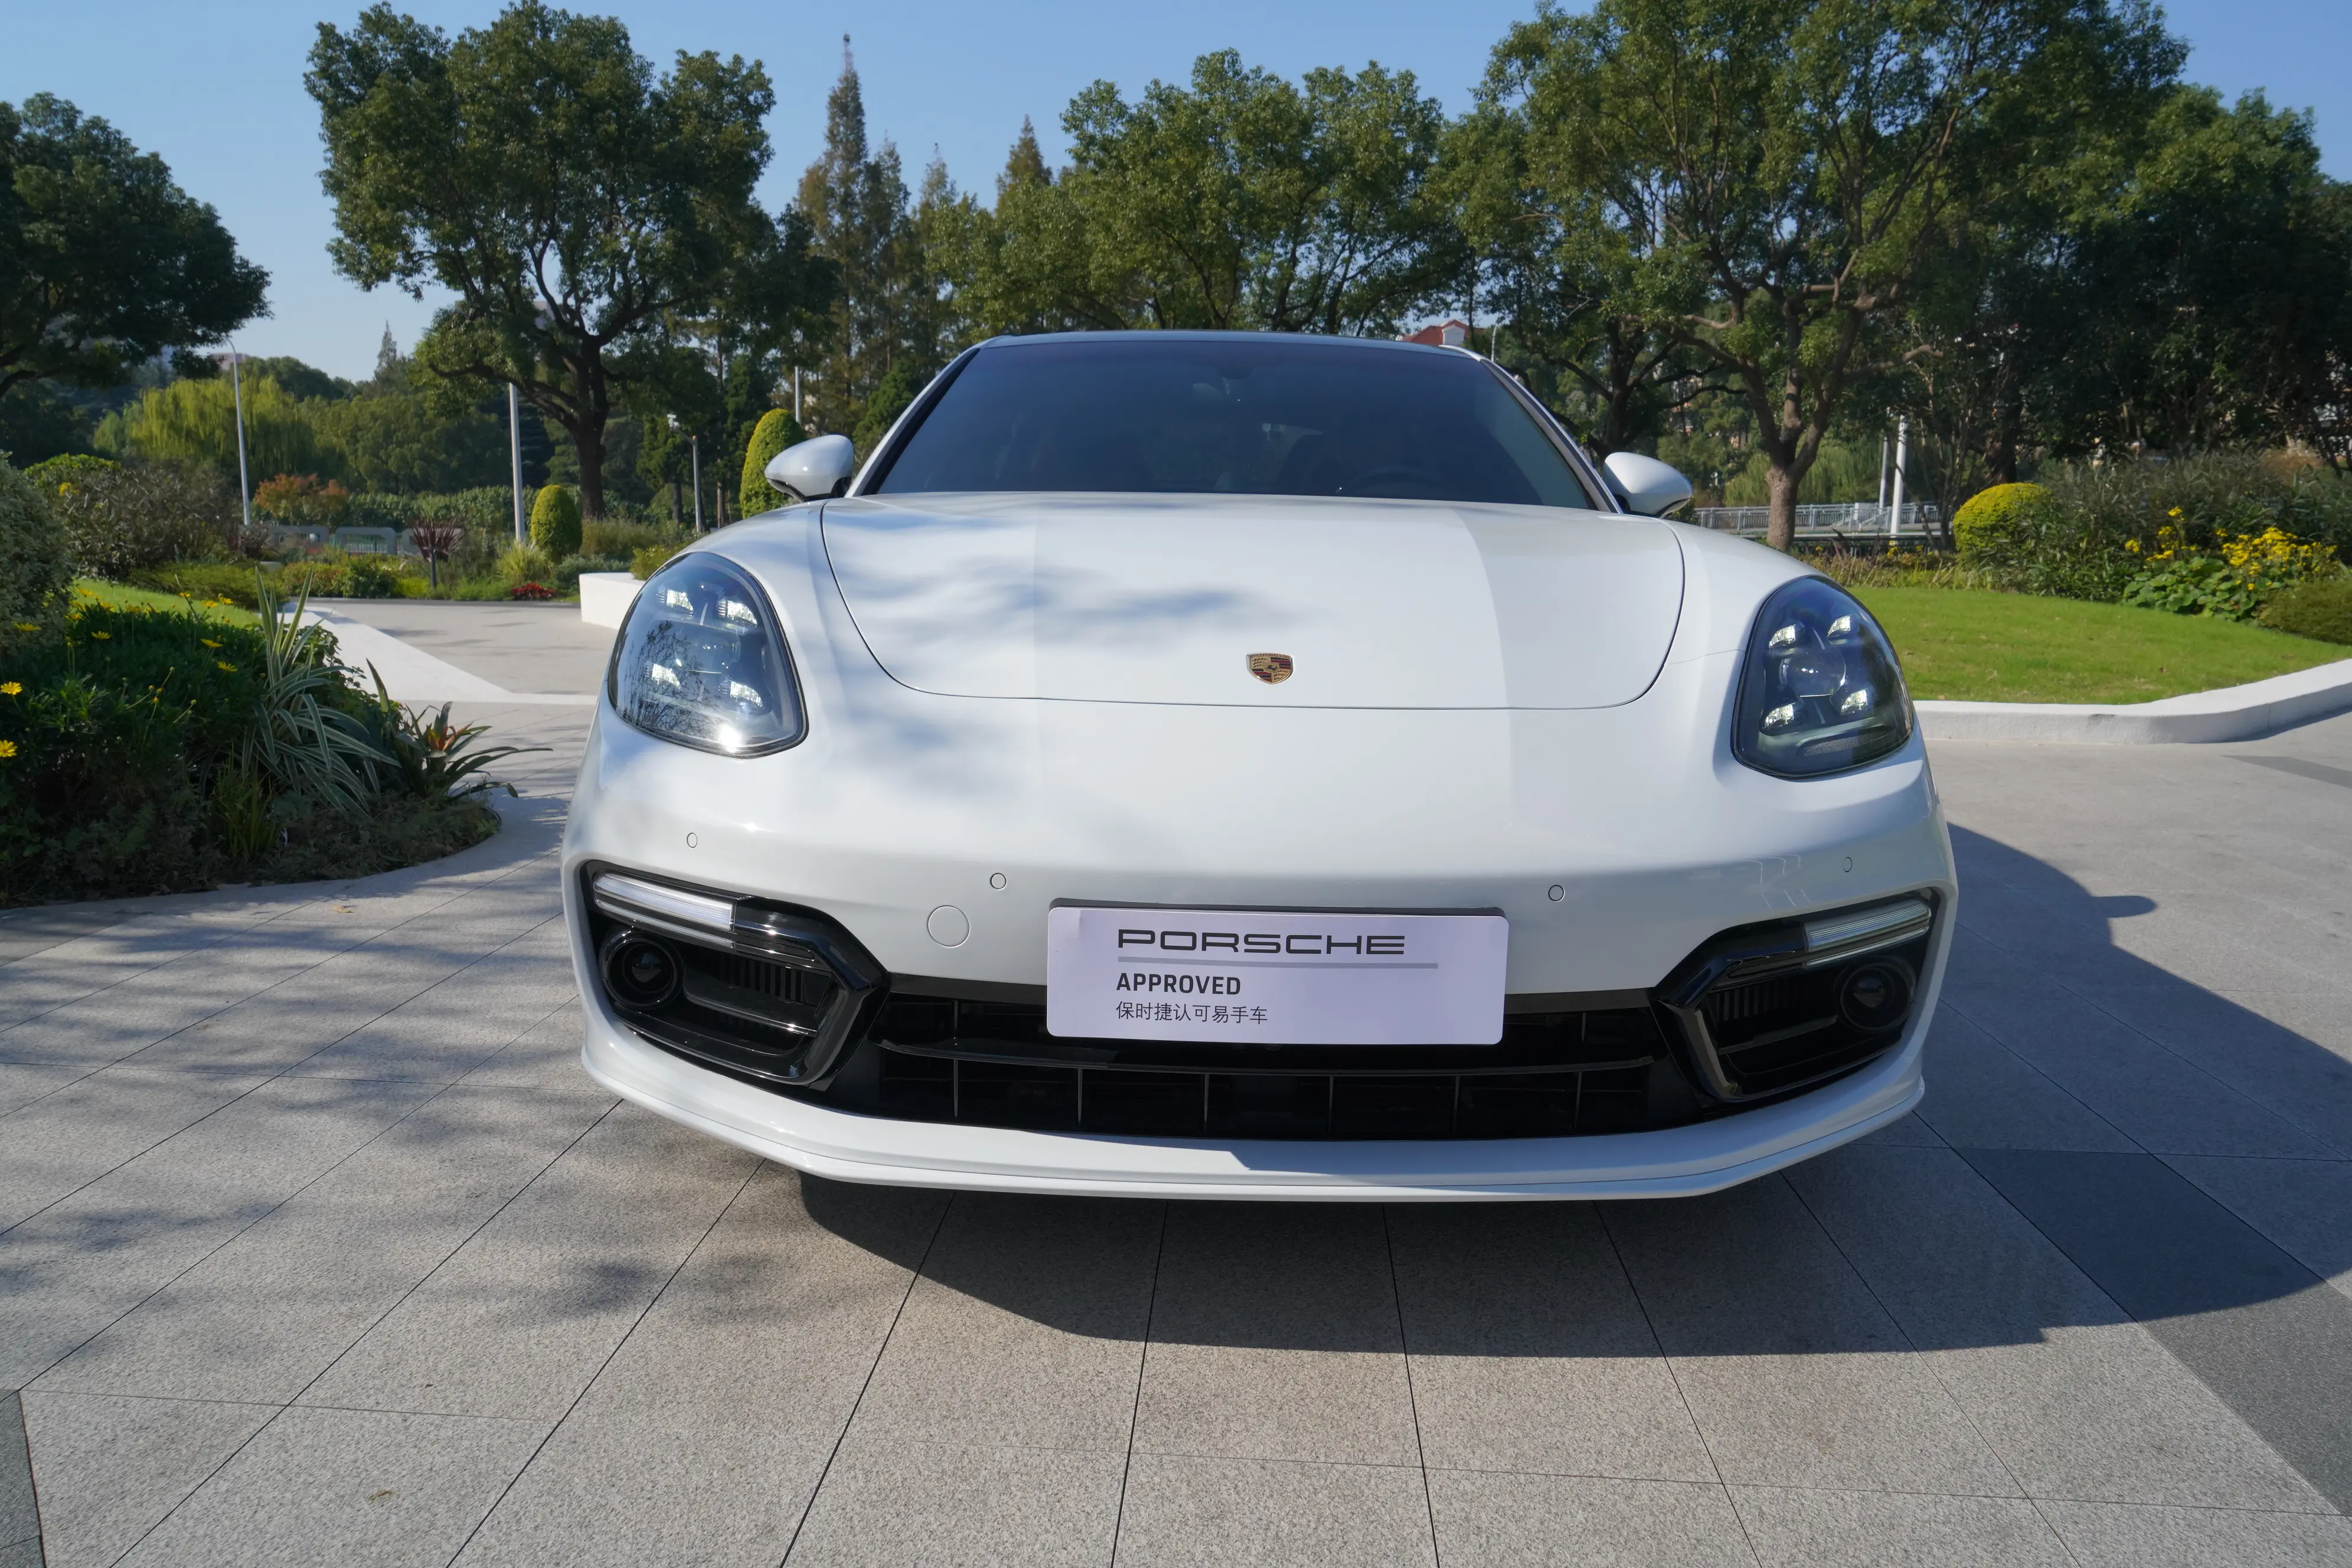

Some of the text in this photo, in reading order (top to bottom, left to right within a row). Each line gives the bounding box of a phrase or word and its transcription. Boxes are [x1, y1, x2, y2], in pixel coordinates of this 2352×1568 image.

[1118, 929, 1405, 955] PORSCHE
[1116, 972, 1241, 995] APPROVED
[1115, 1001, 1268, 1025] 保时捷认可易手车
